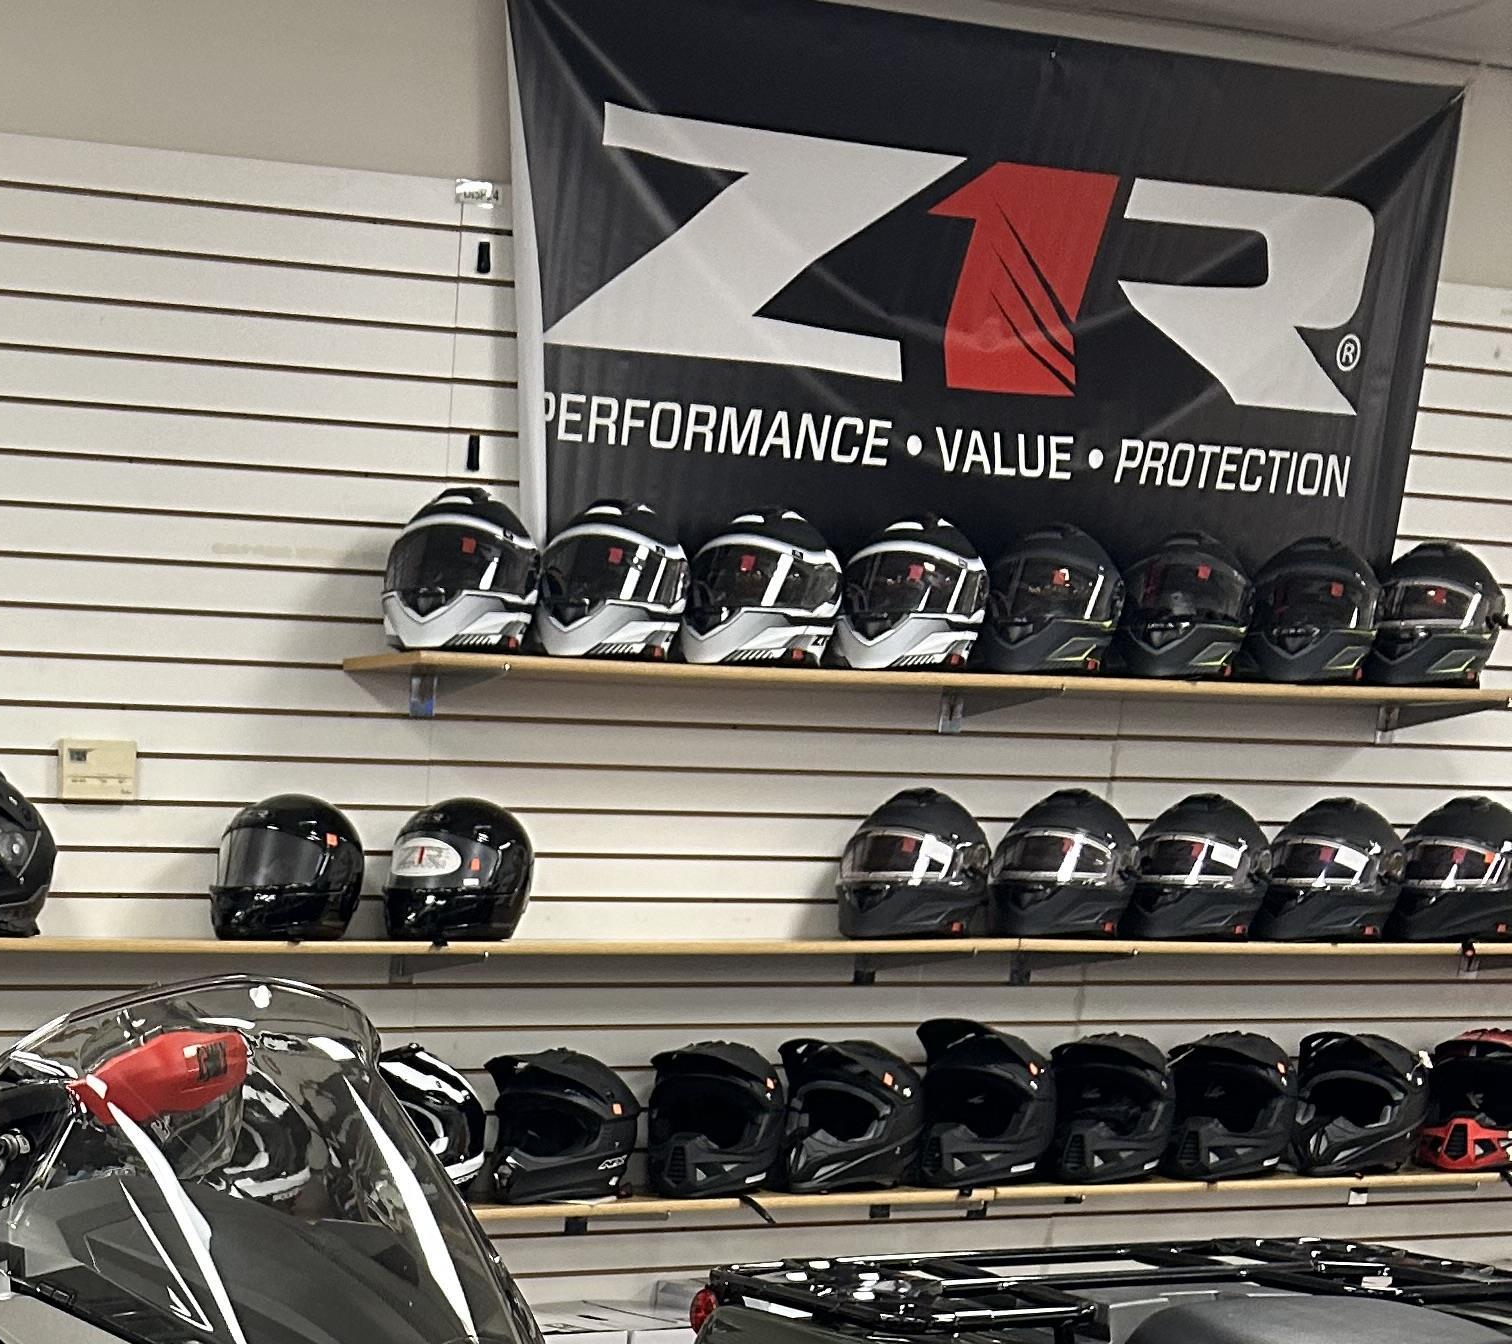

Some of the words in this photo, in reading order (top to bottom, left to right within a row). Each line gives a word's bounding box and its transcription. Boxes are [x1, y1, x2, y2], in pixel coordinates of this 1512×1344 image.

[545, 100, 1377, 416] Z1R
[935, 426, 1074, 480] VALUE
[1114, 438, 1351, 498] PROTECTION
